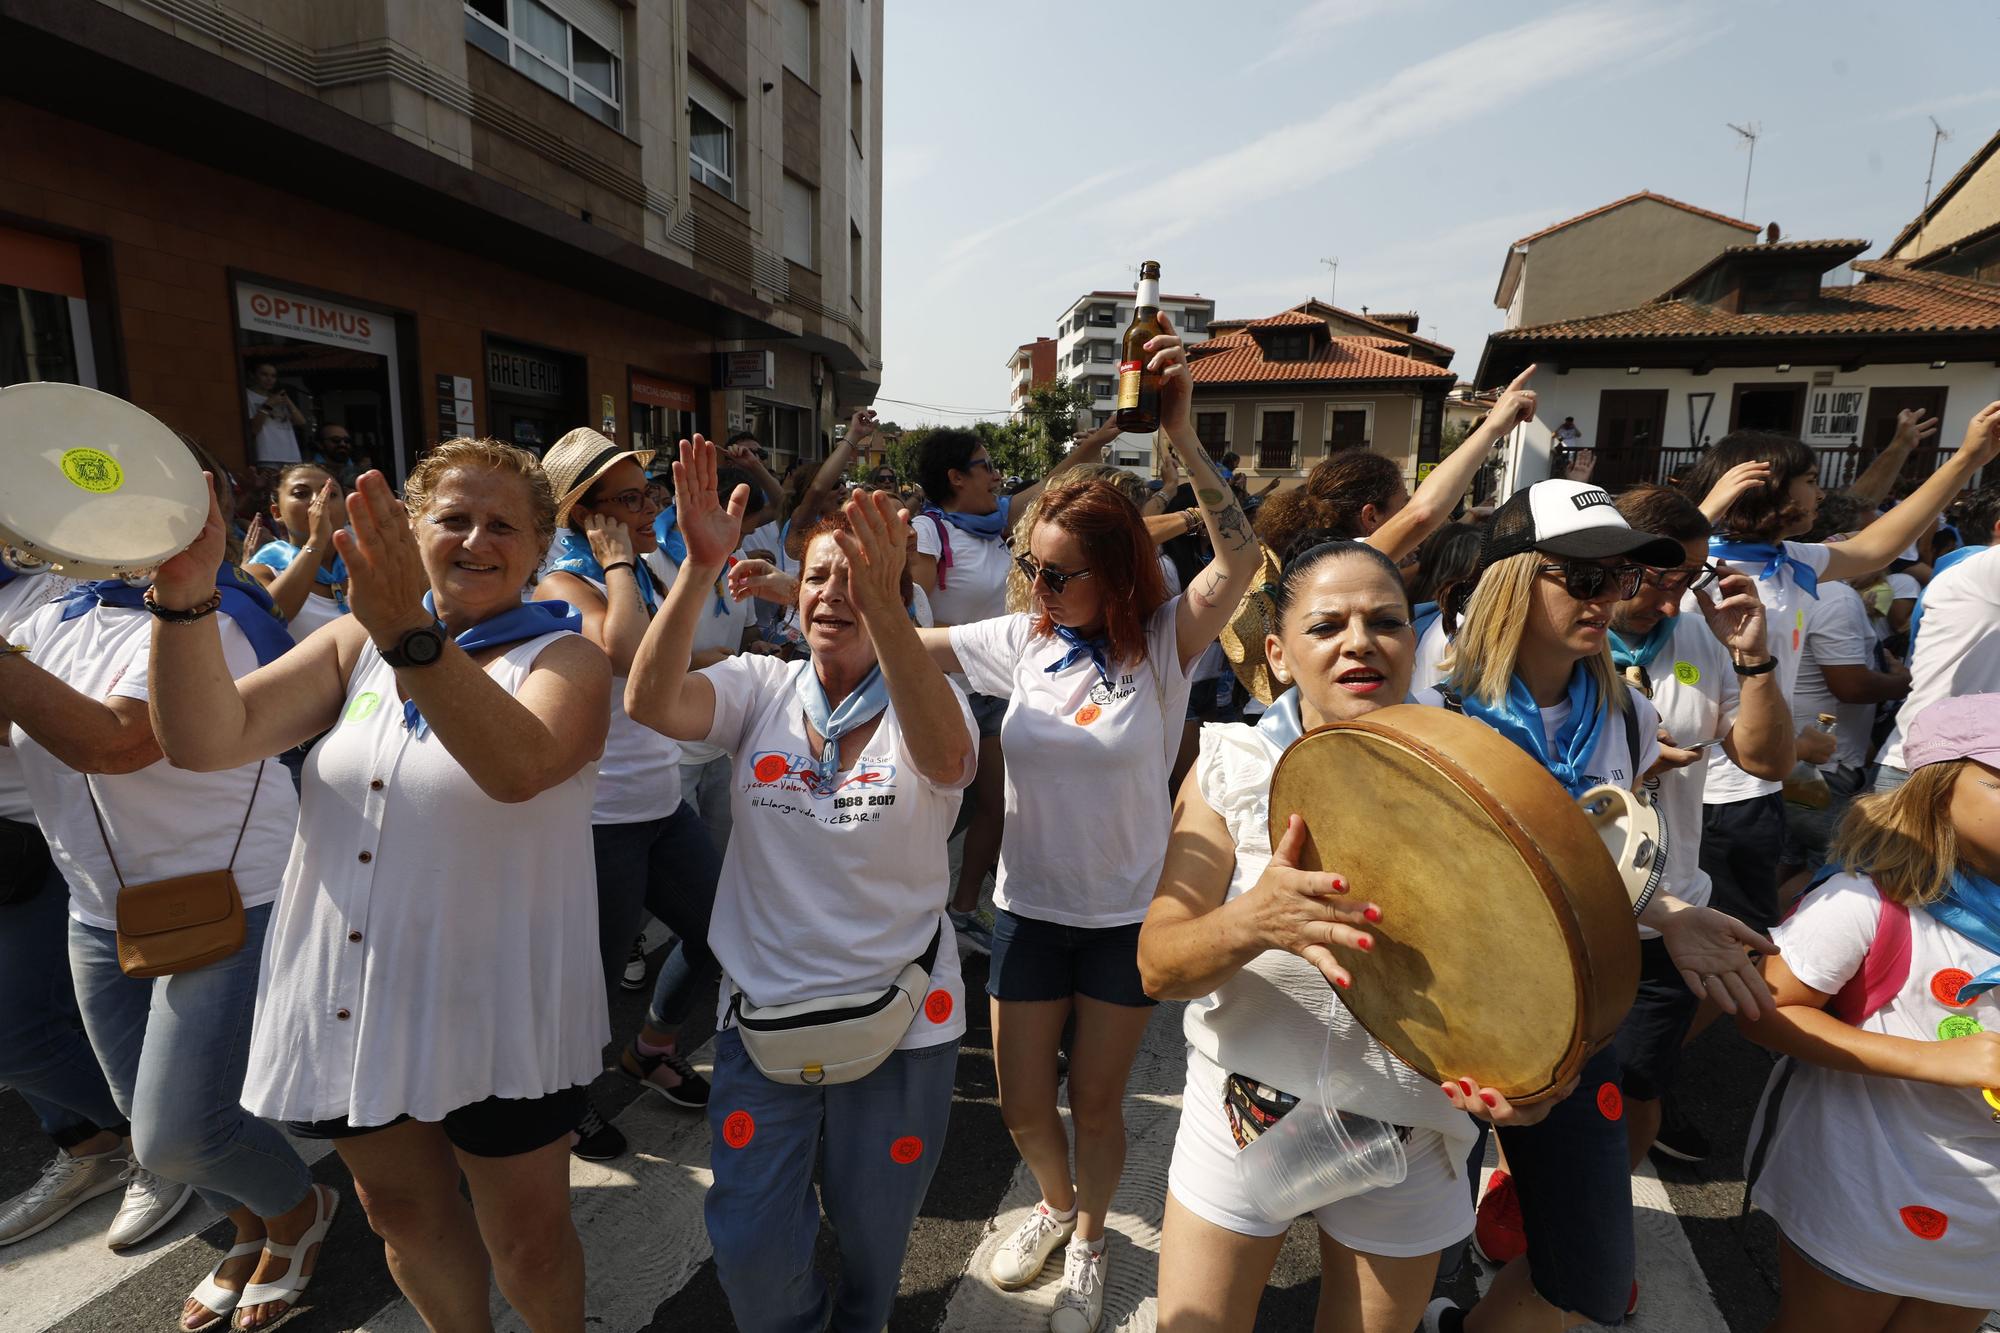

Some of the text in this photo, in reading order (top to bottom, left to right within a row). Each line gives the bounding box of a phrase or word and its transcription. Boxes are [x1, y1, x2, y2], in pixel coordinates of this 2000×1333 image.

[251, 293, 371, 337] OPTIMUS
[489, 352, 560, 393] RRETERIA
[1813, 392, 1827, 414] LA
[1810, 415, 1827, 434] DEL
[833, 795, 896, 809] 1988 2017
